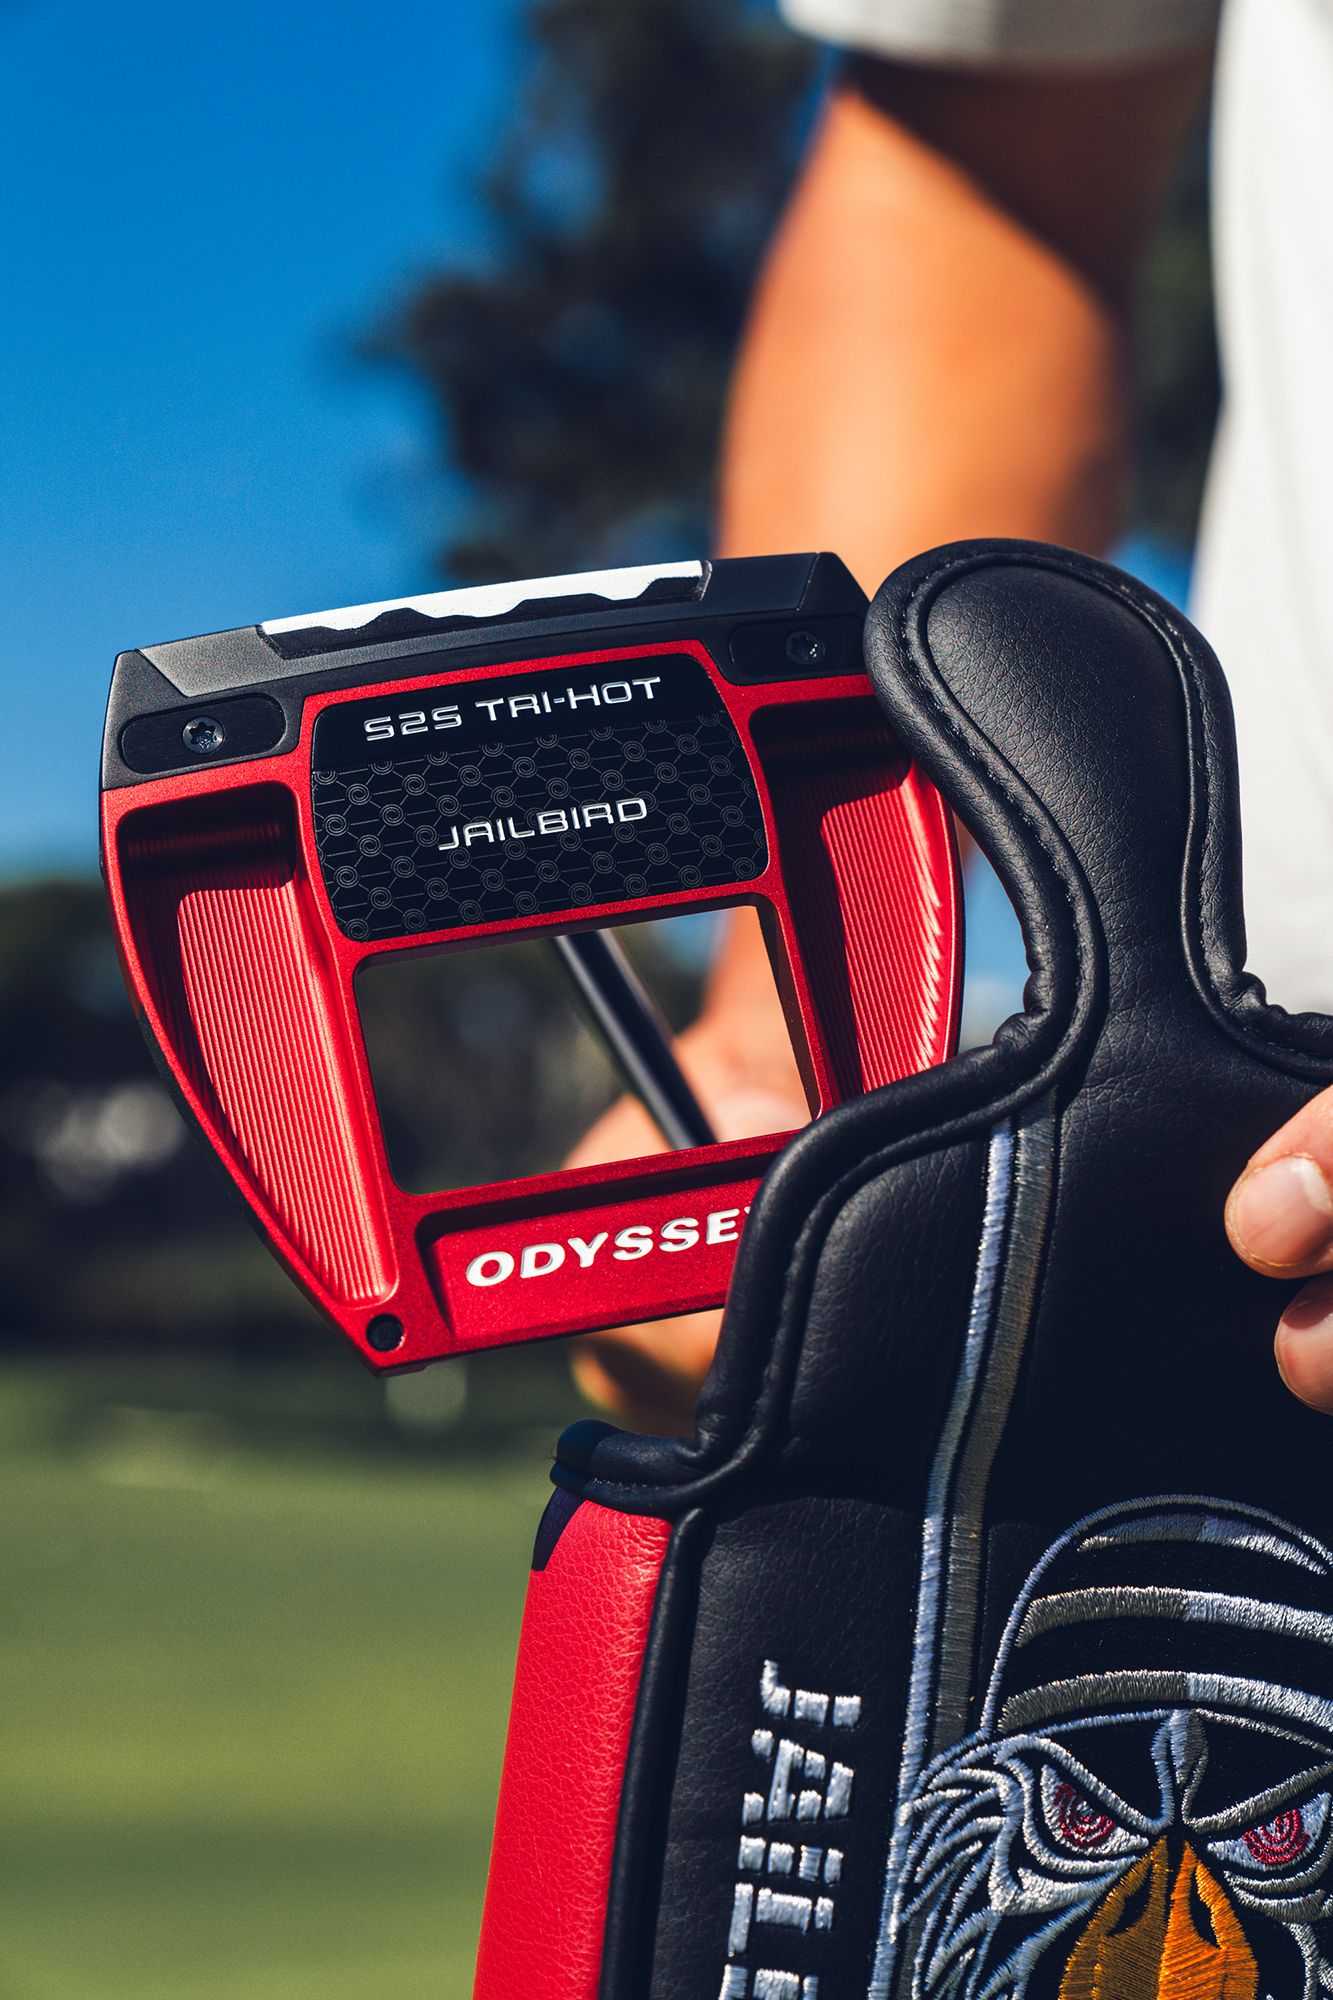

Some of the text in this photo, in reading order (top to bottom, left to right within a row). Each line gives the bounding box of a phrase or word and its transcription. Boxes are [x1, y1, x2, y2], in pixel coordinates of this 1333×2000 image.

[364, 676, 661, 742] S2S TRI-HOT
[438, 797, 648, 851] JAILBIRD
[466, 1206, 751, 1287] ODYSSE
